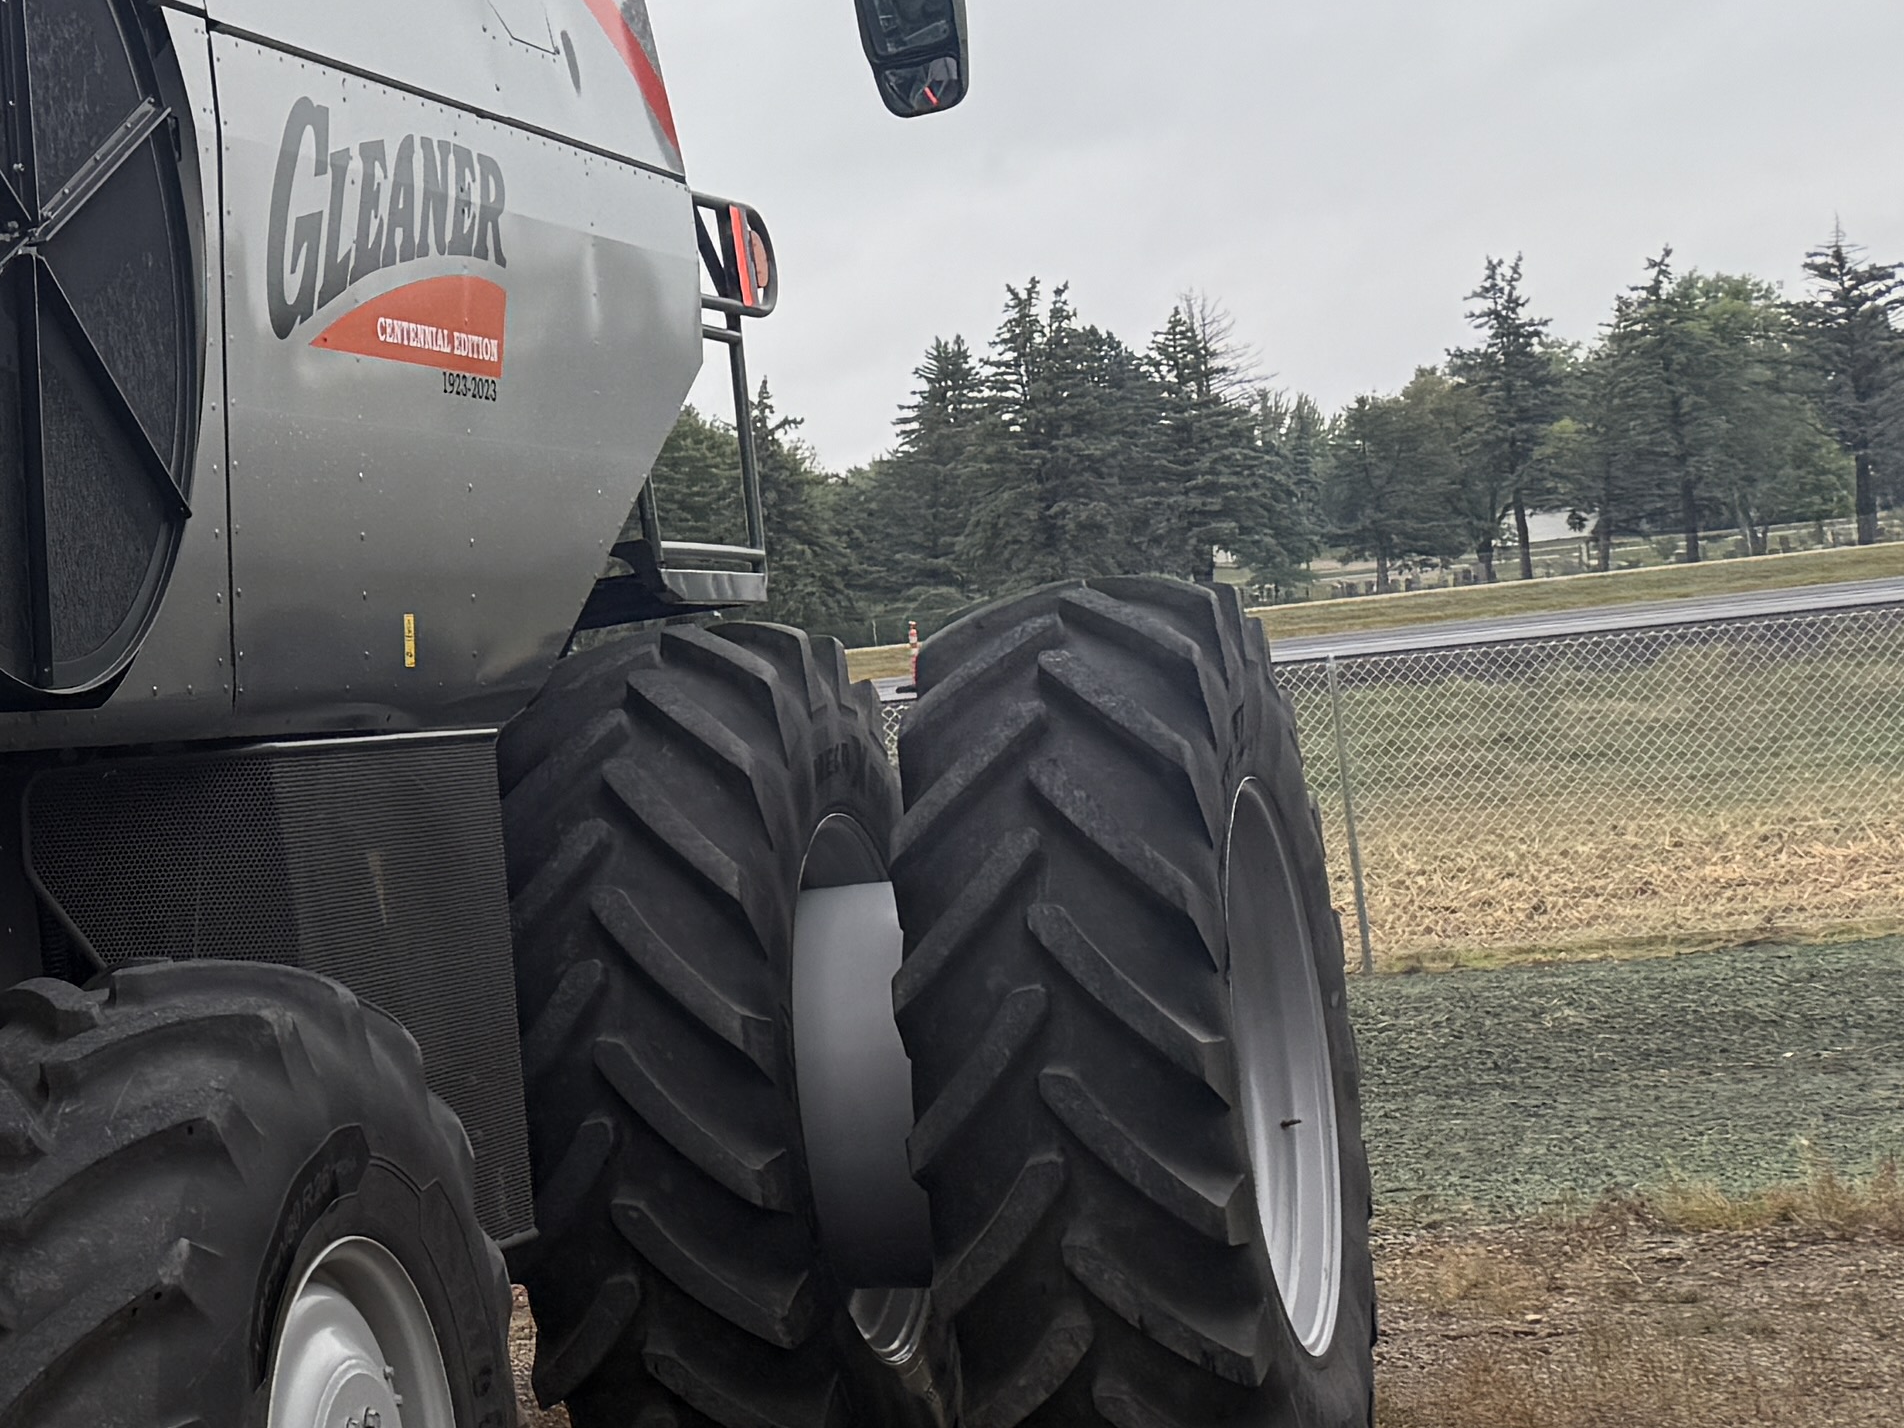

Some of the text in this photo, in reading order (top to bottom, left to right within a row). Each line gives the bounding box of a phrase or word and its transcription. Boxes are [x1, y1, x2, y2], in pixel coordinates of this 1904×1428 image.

[266, 95, 507, 340] GLEANER
[377, 316, 499, 362] CENTENNIAL EDITION
[442, 371, 497, 402] 1923-2023
